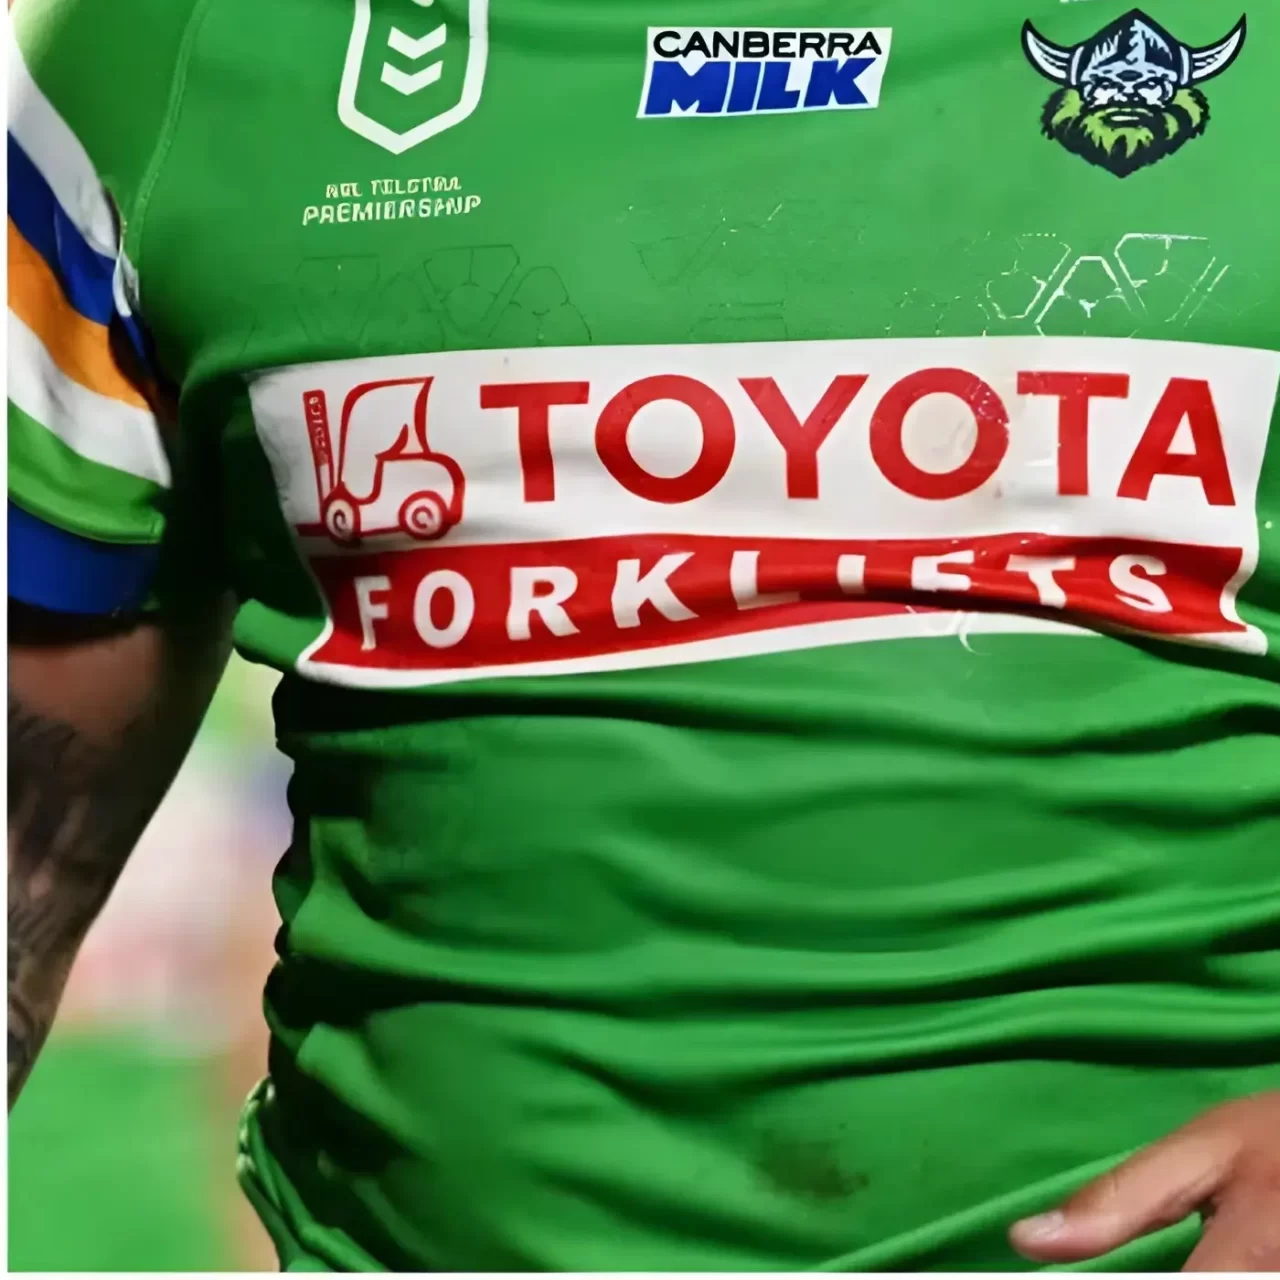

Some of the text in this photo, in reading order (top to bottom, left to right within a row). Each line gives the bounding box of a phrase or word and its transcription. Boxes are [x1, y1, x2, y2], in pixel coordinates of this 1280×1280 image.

[653, 30, 882, 58] CANBERRA
[644, 57, 876, 115] MILK
[479, 366, 1236, 507] TOYOTA
[357, 549, 1174, 652] FORKLIFTS
